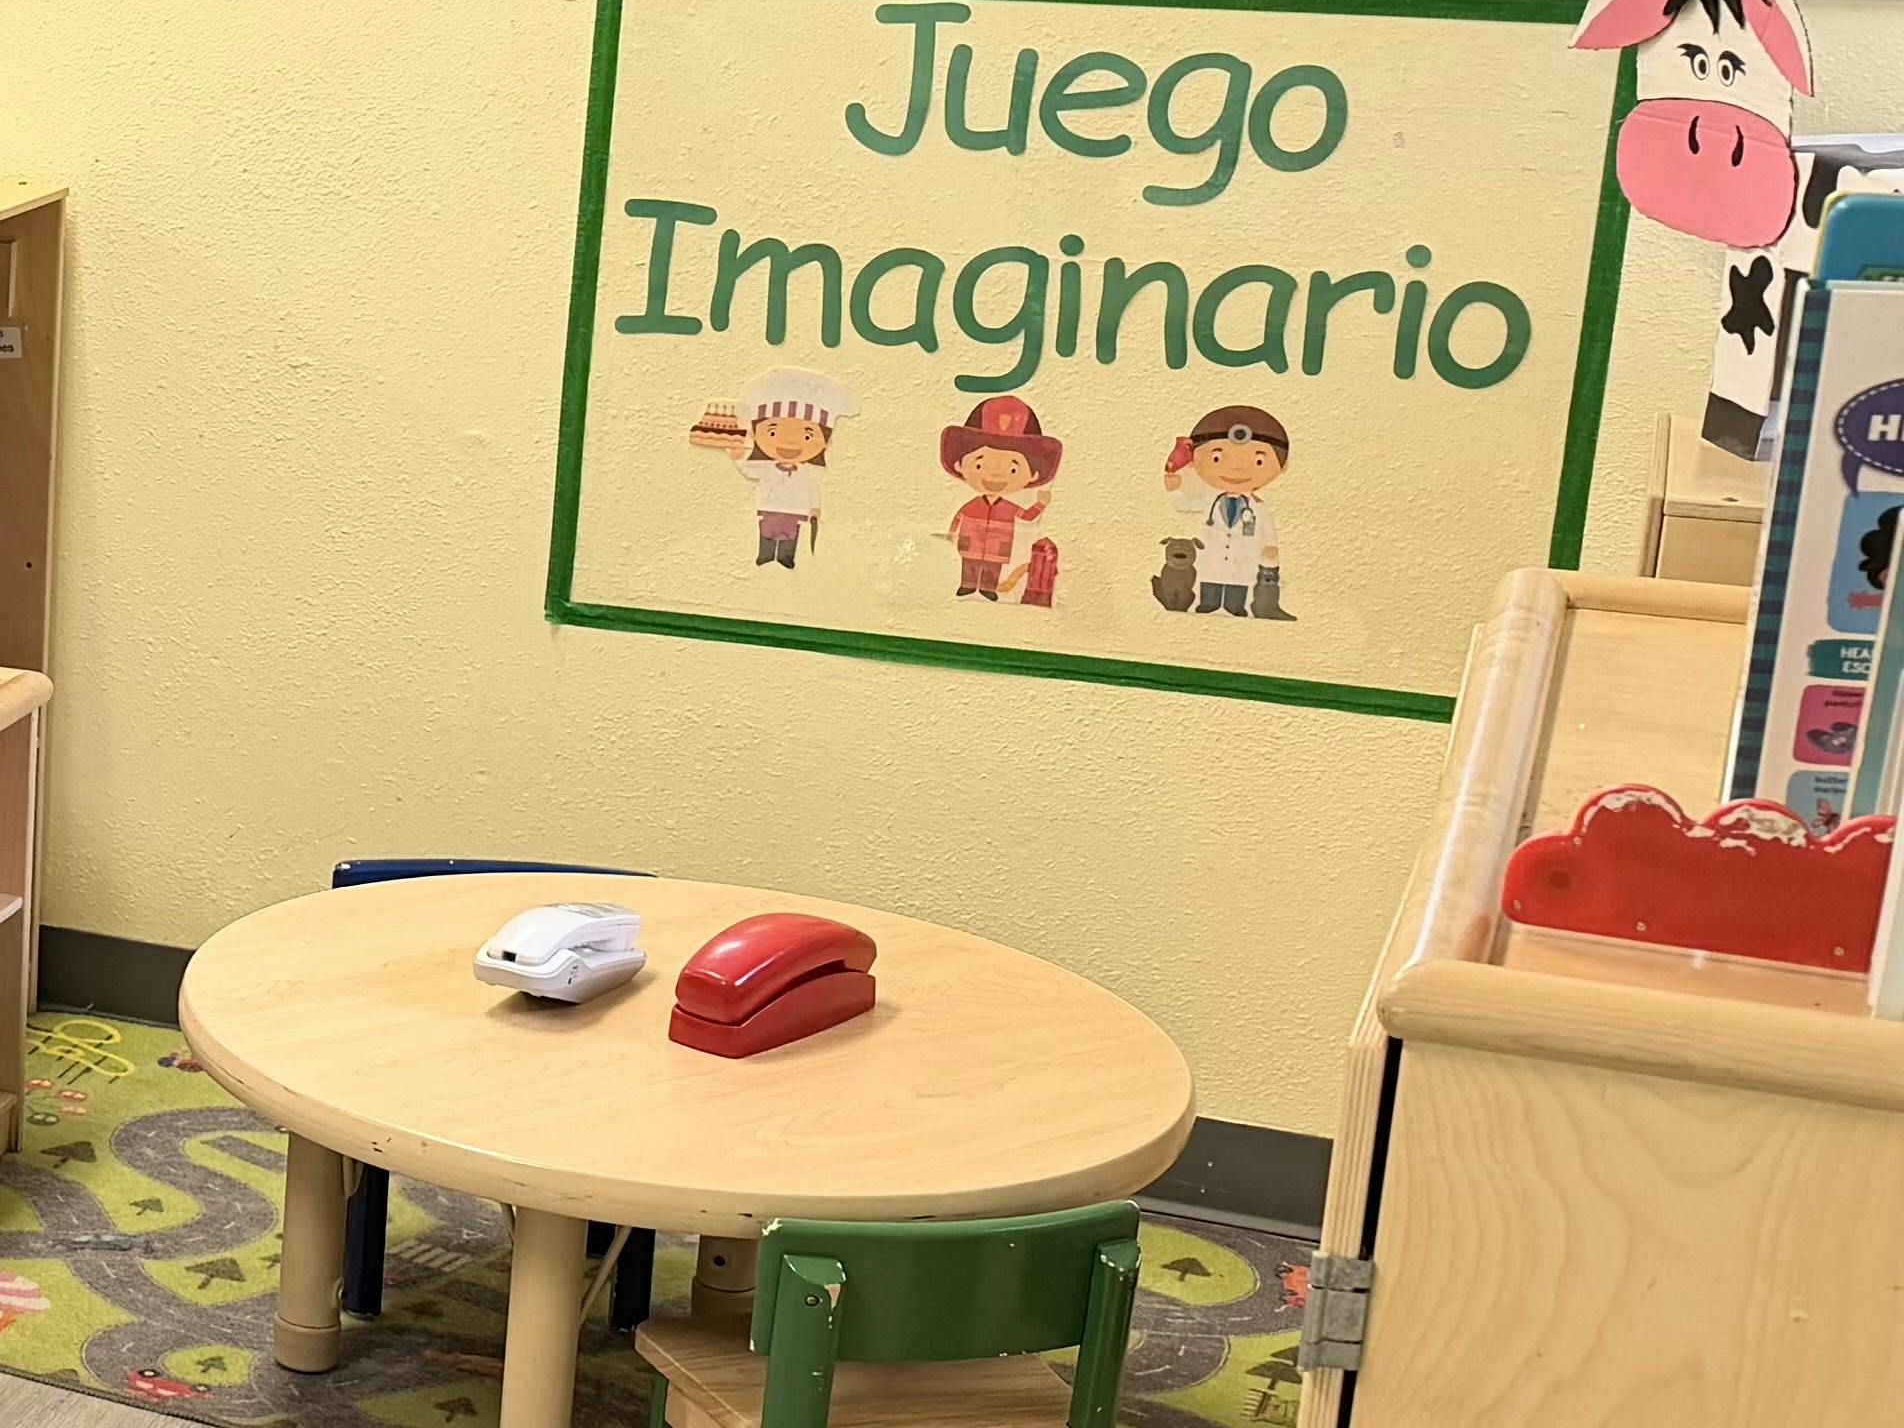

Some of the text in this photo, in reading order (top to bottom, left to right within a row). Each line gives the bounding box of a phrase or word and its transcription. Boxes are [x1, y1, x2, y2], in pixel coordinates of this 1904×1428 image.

[843, 1, 1348, 207] Juego
[614, 197, 1532, 394] Imaginario
[1867, 414, 1904, 442] H
[1840, 647, 1874, 660] HEA
